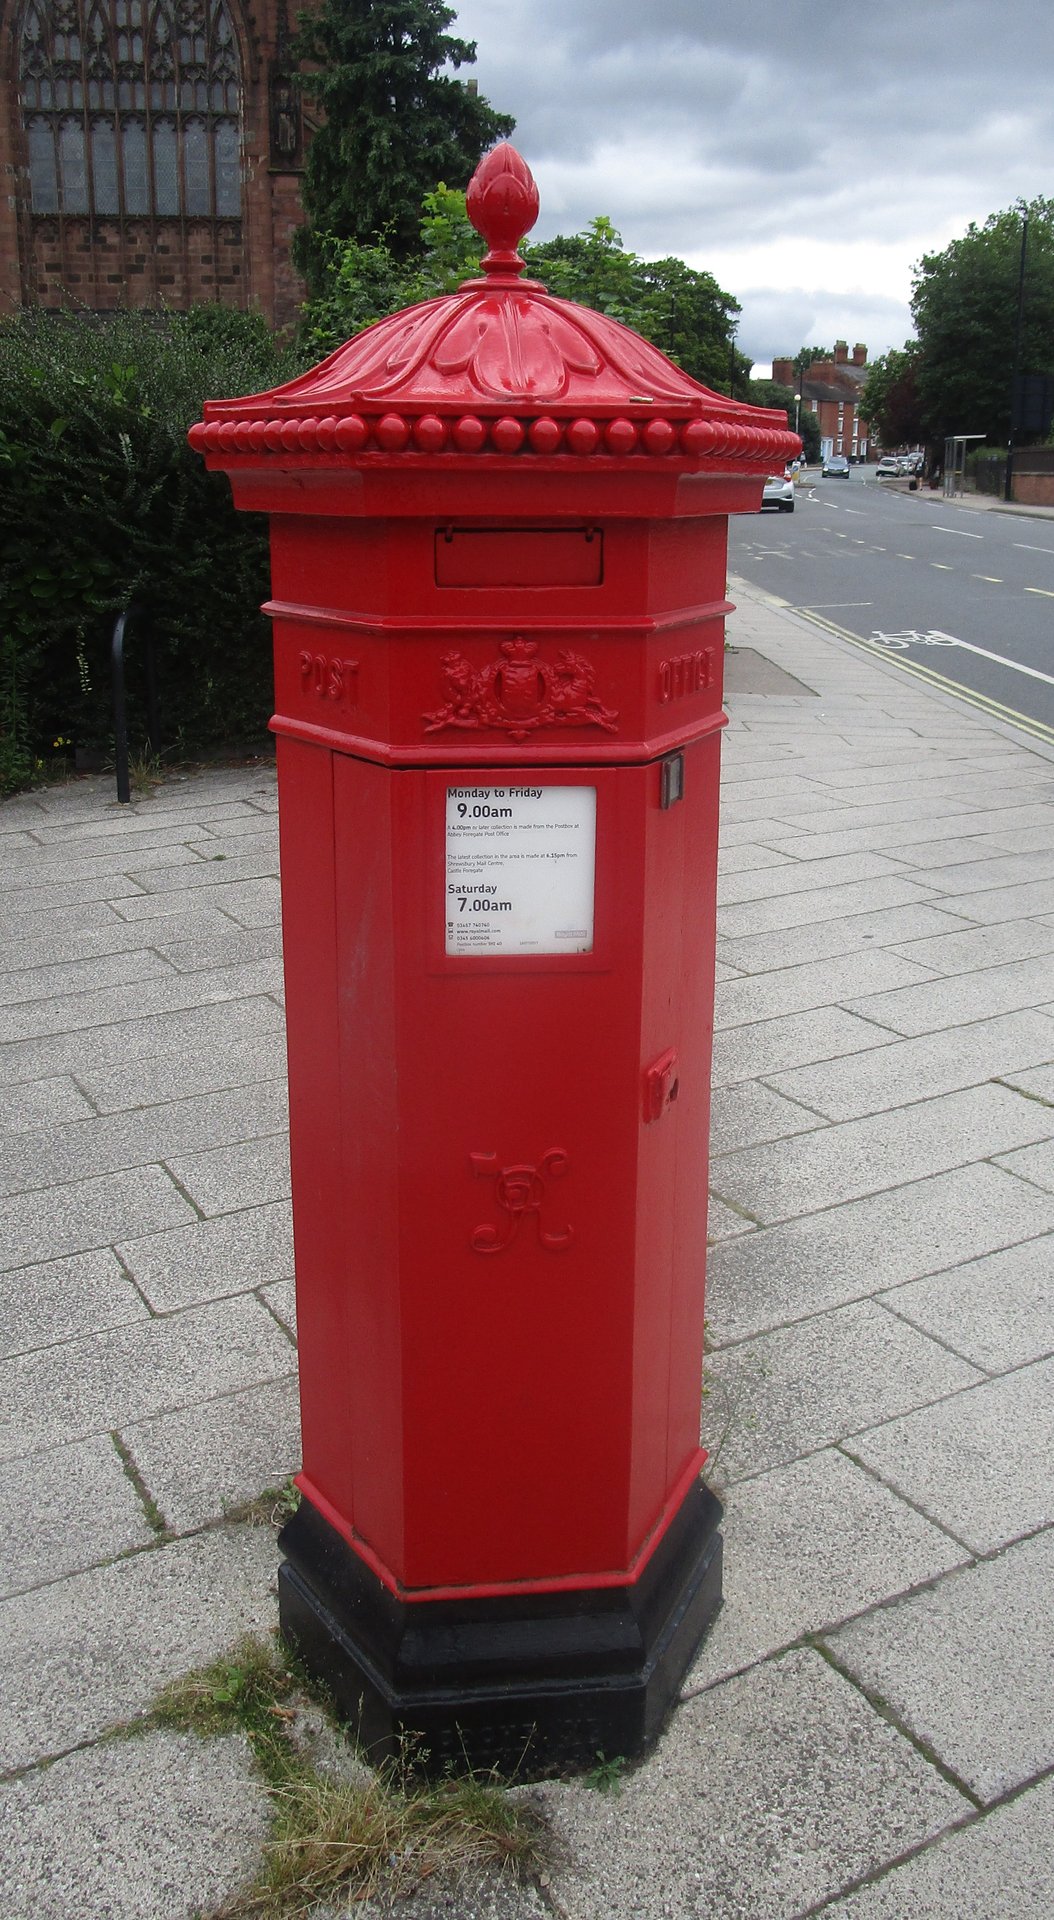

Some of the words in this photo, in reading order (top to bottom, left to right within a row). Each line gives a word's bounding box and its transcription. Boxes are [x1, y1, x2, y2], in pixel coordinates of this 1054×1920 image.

[297, 650, 360, 705] POST
[658, 646, 716, 705] OFFICE
[448, 788, 490, 800] Monday
[494, 788, 505, 798] to
[509, 787, 543, 800] Friday
[457, 802, 513, 818] 9.00am
[448, 884, 497, 894] Saturday
[457, 897, 512, 912] 7.00am
